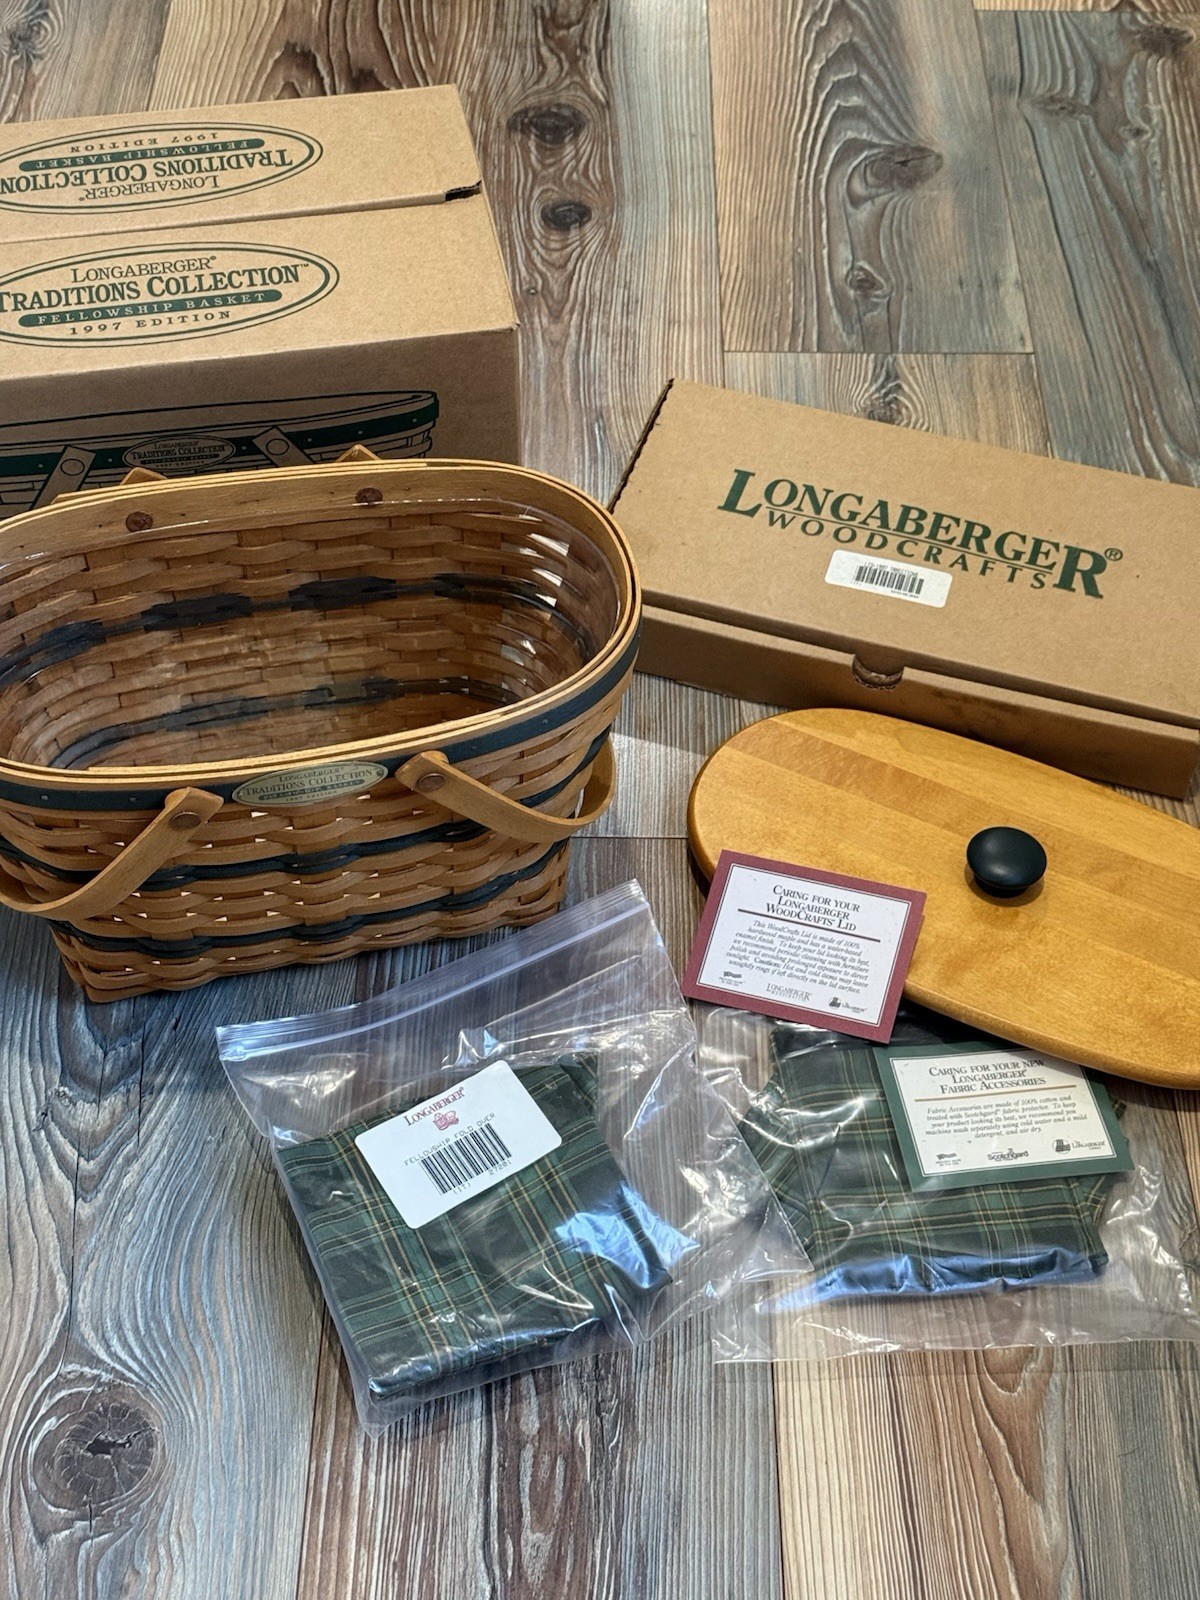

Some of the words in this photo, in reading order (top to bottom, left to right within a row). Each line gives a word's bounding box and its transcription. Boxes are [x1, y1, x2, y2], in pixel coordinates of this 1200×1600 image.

[70, 138, 157, 153] EDITION
[124, 141, 247, 159] FELLOWSHIP
[172, 133, 217, 143] 1997
[36, 154, 111, 168] BASKET
[153, 150, 292, 177] TRADITIONS
[1, 164, 147, 194] COLLECTION
[83, 175, 219, 200] LONGABERGER
[71, 257, 213, 283] LONGABERGER
[0, 281, 141, 313] TRADITIONS
[38, 303, 172, 324] FELLOWSHIP
[186, 293, 264, 309] BASKET
[70, 322, 121, 335] 1997
[136, 311, 230, 328] EDITION
[179, 445, 225, 455] COLLECTION
[769, 510, 1046, 589] WOODCRAFTS
[245, 782, 305, 796] TRADITIONS
[309, 770, 372, 786] COLLECTION
[279, 768, 339, 782] LONGABERGER
[773, 885, 809, 901] CARING
[811, 895, 831, 906] FOR
[835, 900, 860, 912] YOUR
[777, 896, 850, 920] LONGABERGER
[753, 920, 766, 928] This
[767, 923, 800, 936] WoodCrafts
[819, 936, 835, 944] made
[844, 941, 860, 949] 100%
[837, 919, 856, 931] LID
[735, 932, 758, 940] enamel
[788, 942, 802, 952] keep
[826, 951, 848, 962] looking
[747, 926, 777, 938] hardwood
[777, 934, 796, 942] maple
[810, 940, 820, 948] has
[827, 945, 863, 957] water-based
[729, 945, 747, 953] polish
[761, 953, 787, 963] avoiding
[787, 958, 817, 969] prolonged
[817, 965, 843, 974] exposure
[850, 972, 869, 980] direct
[742, 941, 777, 952] recommend
[776, 948, 801, 958] periodic
[801, 953, 827, 965] cleaning
[840, 961, 869, 973] furniture
[929, 1067, 967, 1076] CARING
[970, 1065, 991, 1073] FOR
[992, 1062, 1020, 1071] YOUR
[1023, 1059, 1045, 1067] NEW
[939, 1084, 977, 1094] FABRIC
[980, 1077, 1046, 1090] ACCESSORIES
[949, 1104, 982, 1112] Accessories
[971, 1117, 993, 1125] looking
[1028, 1109, 1064, 1118] recommend
[454, 1126, 474, 1139] FOLD
[970, 1123, 1001, 1132] separately
[488, 1159, 512, 1176] 27201
